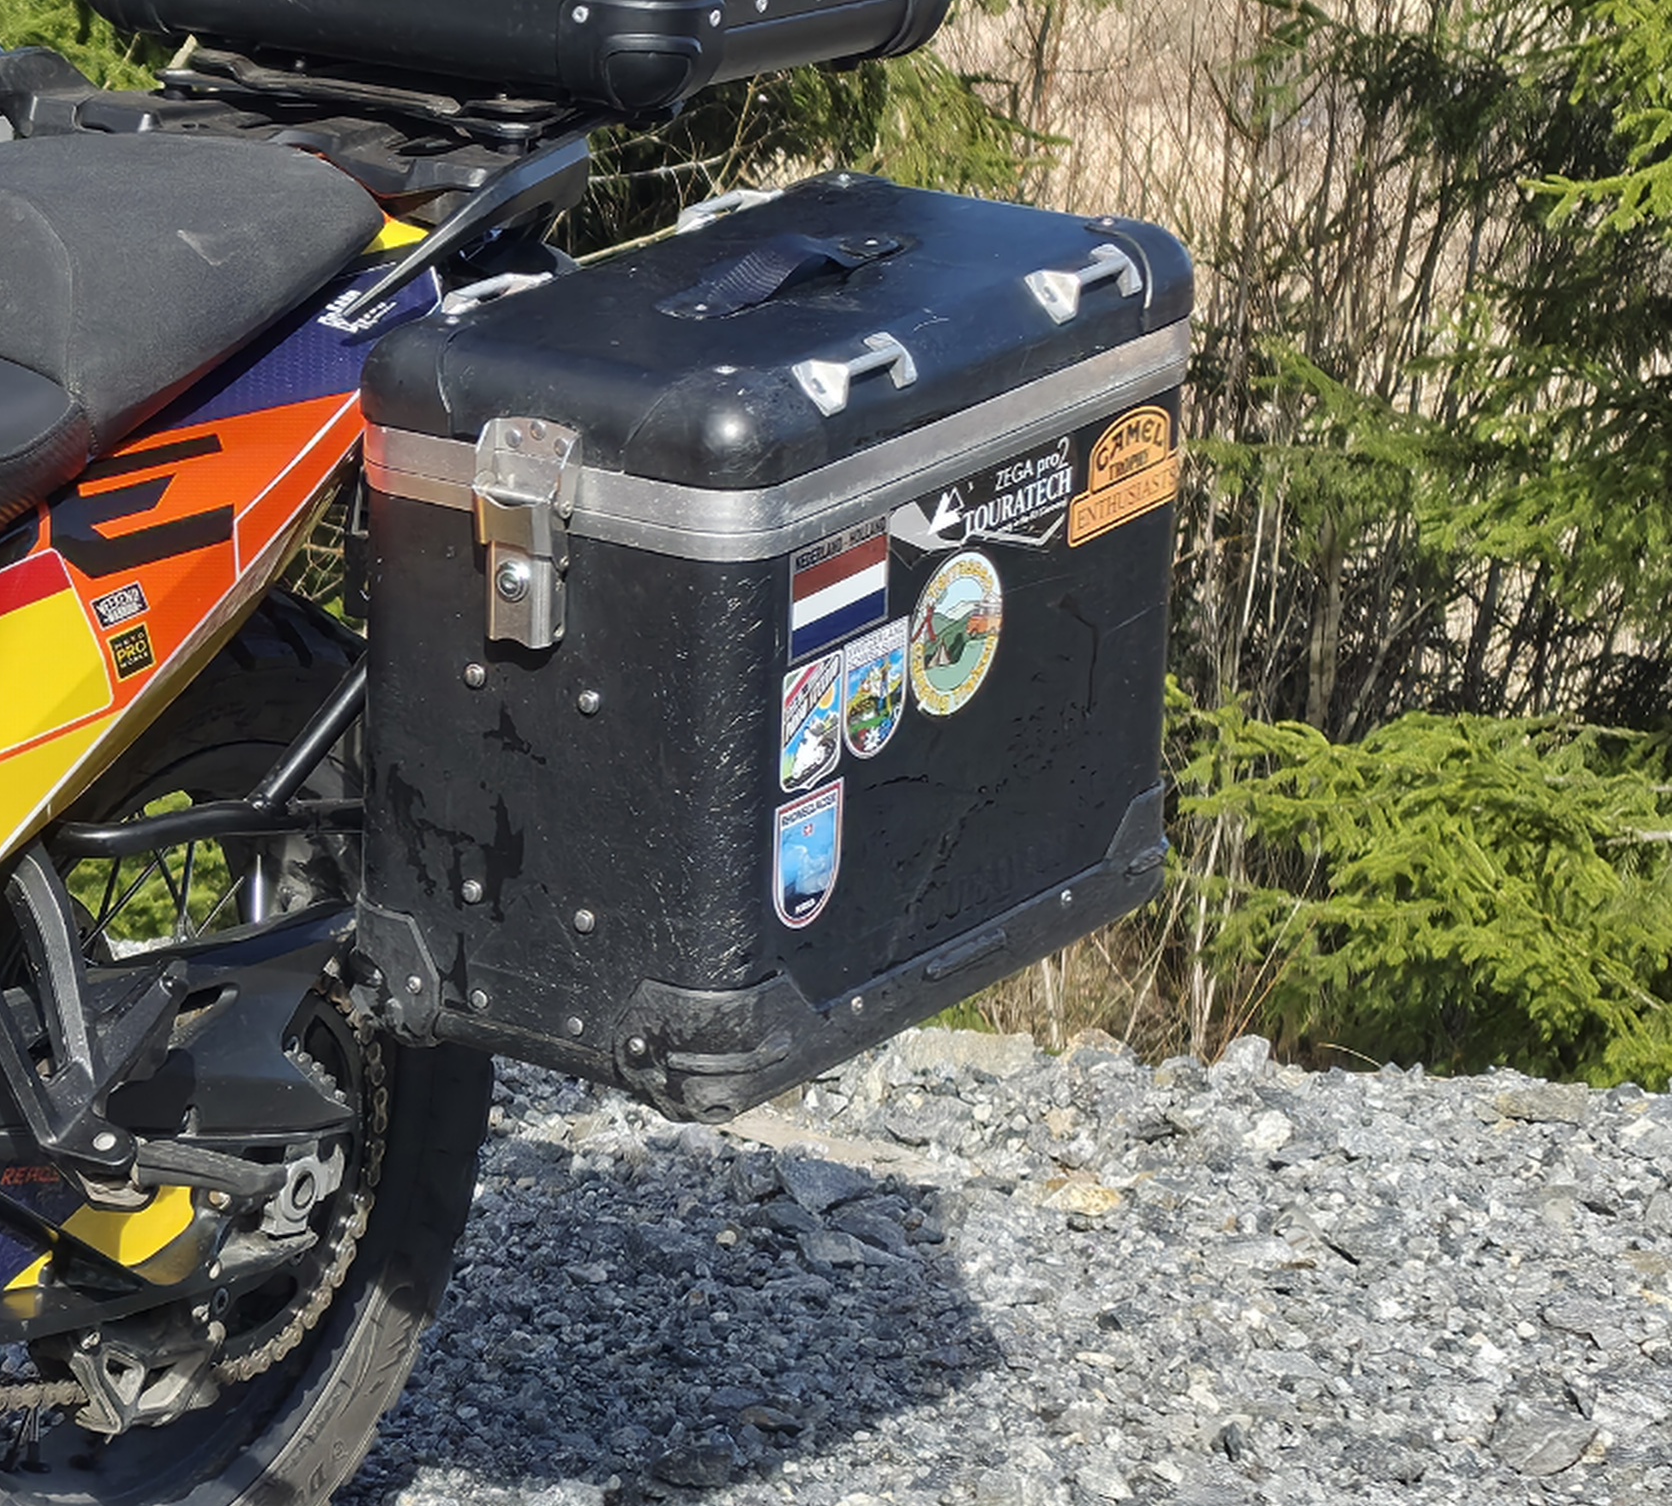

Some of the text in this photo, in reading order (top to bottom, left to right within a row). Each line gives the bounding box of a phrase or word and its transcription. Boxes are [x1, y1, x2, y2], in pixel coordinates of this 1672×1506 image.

[994, 436, 1070, 492] ZEGA pro2
[1096, 418, 1164, 472] CAMEL
[1108, 449, 1149, 482] TROPHY
[962, 466, 1074, 536] TOURATECH
[1077, 463, 1179, 531] ENTHUSIASTS
[117, 640, 147, 663] PRO
